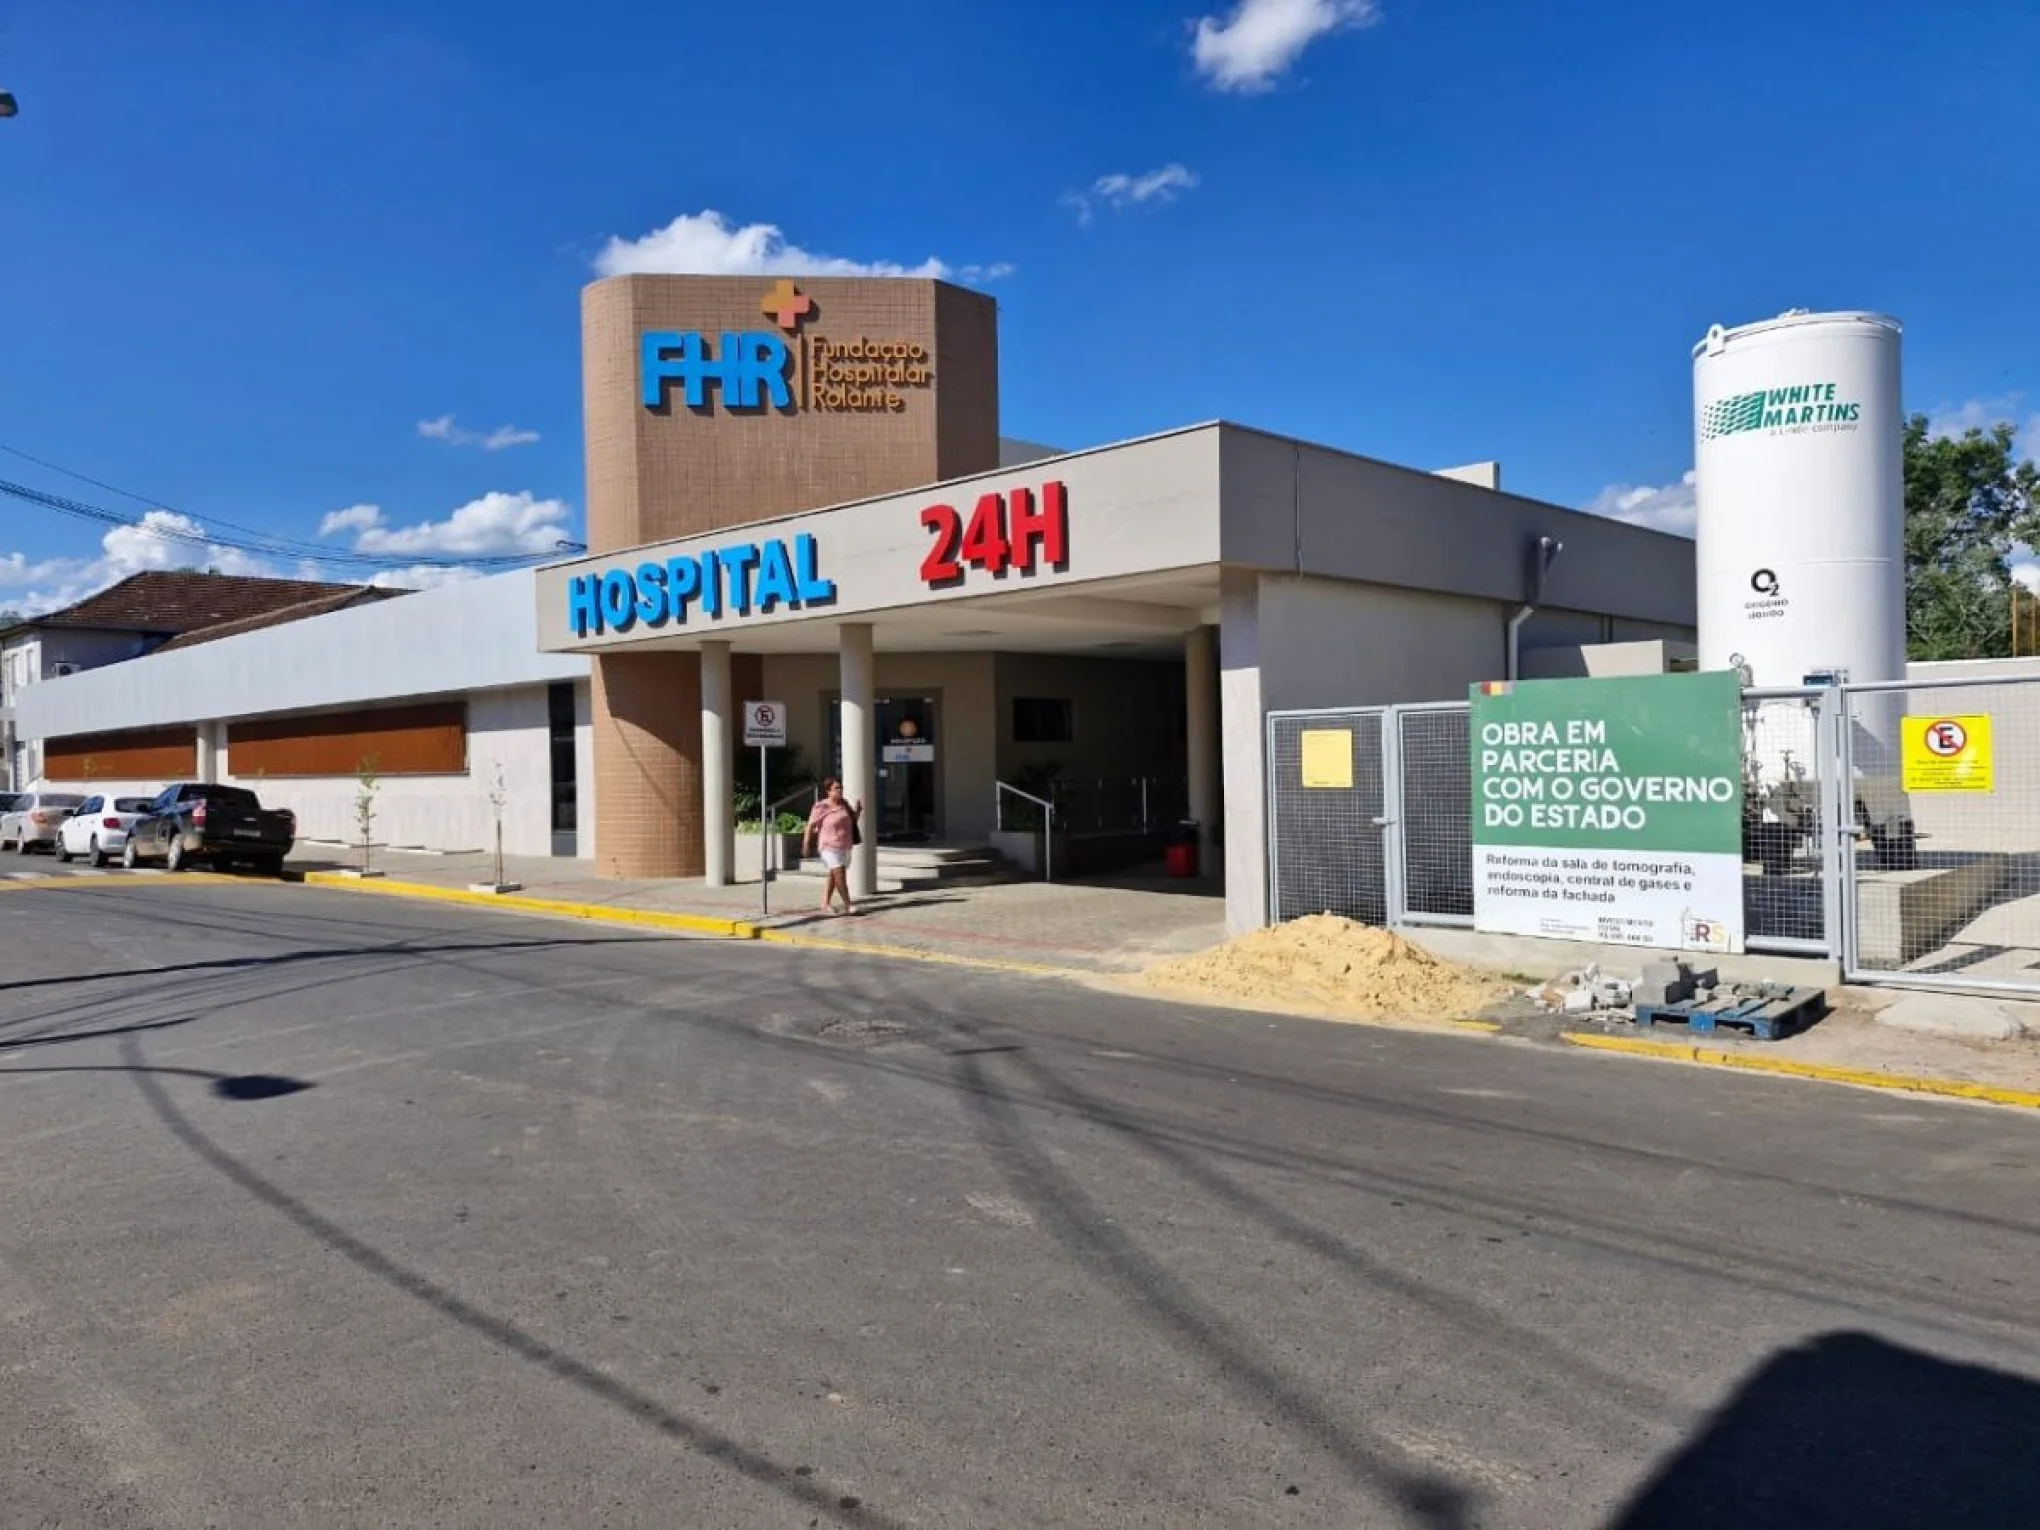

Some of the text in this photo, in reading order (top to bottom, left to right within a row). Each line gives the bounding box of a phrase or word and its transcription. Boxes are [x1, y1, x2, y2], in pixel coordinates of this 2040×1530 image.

[812, 337, 924, 360] Fundação
[640, 330, 790, 408] FHR
[812, 361, 932, 384] Hospitalar
[812, 383, 902, 408] Rolante
[1768, 383, 1836, 406] WHITE
[1763, 403, 1860, 427] MARTINS
[568, 481, 1069, 638] HOSPITAL 24H
[1482, 720, 1606, 745] OBRA EM
[1482, 749, 1620, 773] PARCERIA
[1483, 777, 1734, 802] COM O GOVERNO
[1485, 804, 1647, 829] DO ESTADO
[1486, 854, 1539, 868] Reforma
[1541, 856, 1559, 868] da
[1562, 858, 1589, 870] sala
[1591, 859, 1609, 871] de
[1487, 886, 1616, 903] reforma da fachada
[1567, 874, 1615, 888] central
[1618, 876, 1636, 888] de
[1639, 879, 1681, 892] gases
[1683, 881, 1693, 891] e
